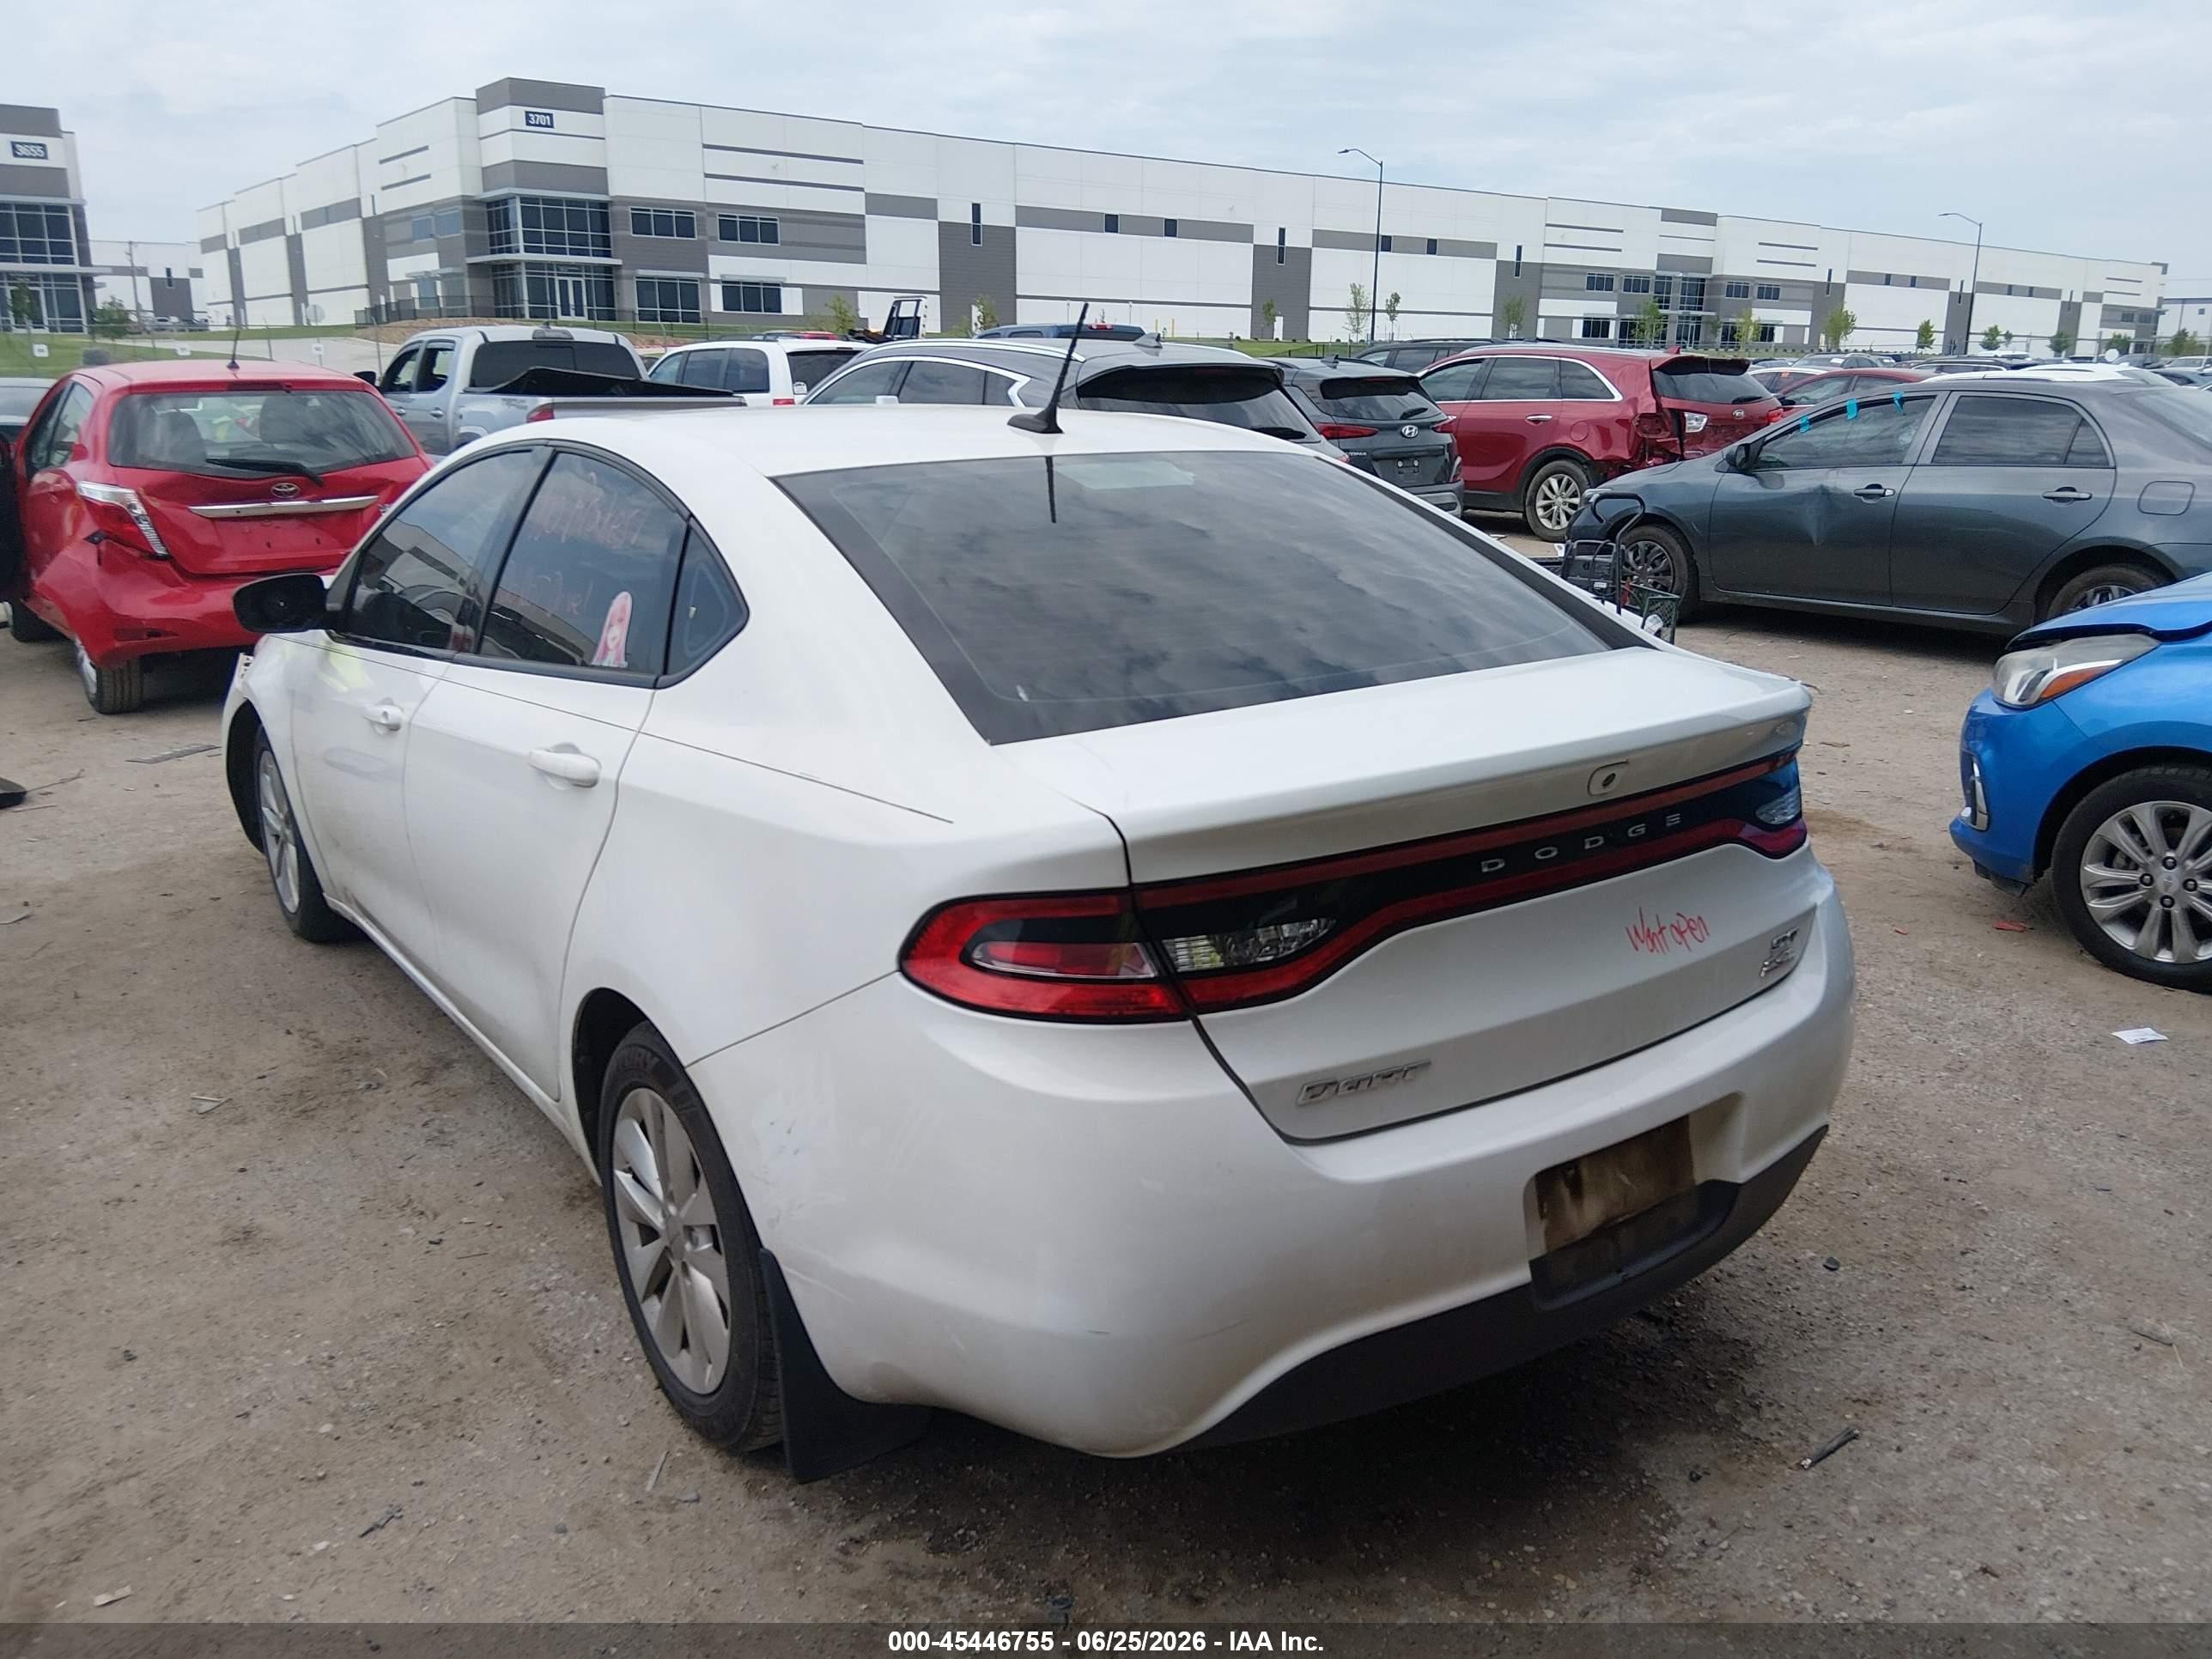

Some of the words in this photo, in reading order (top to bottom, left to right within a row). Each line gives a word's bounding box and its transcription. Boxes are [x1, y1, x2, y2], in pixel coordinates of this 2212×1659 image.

[528, 112, 551, 126] 3701
[15, 143, 45, 157] 3655
[1481, 813, 1680, 872] DODGE
